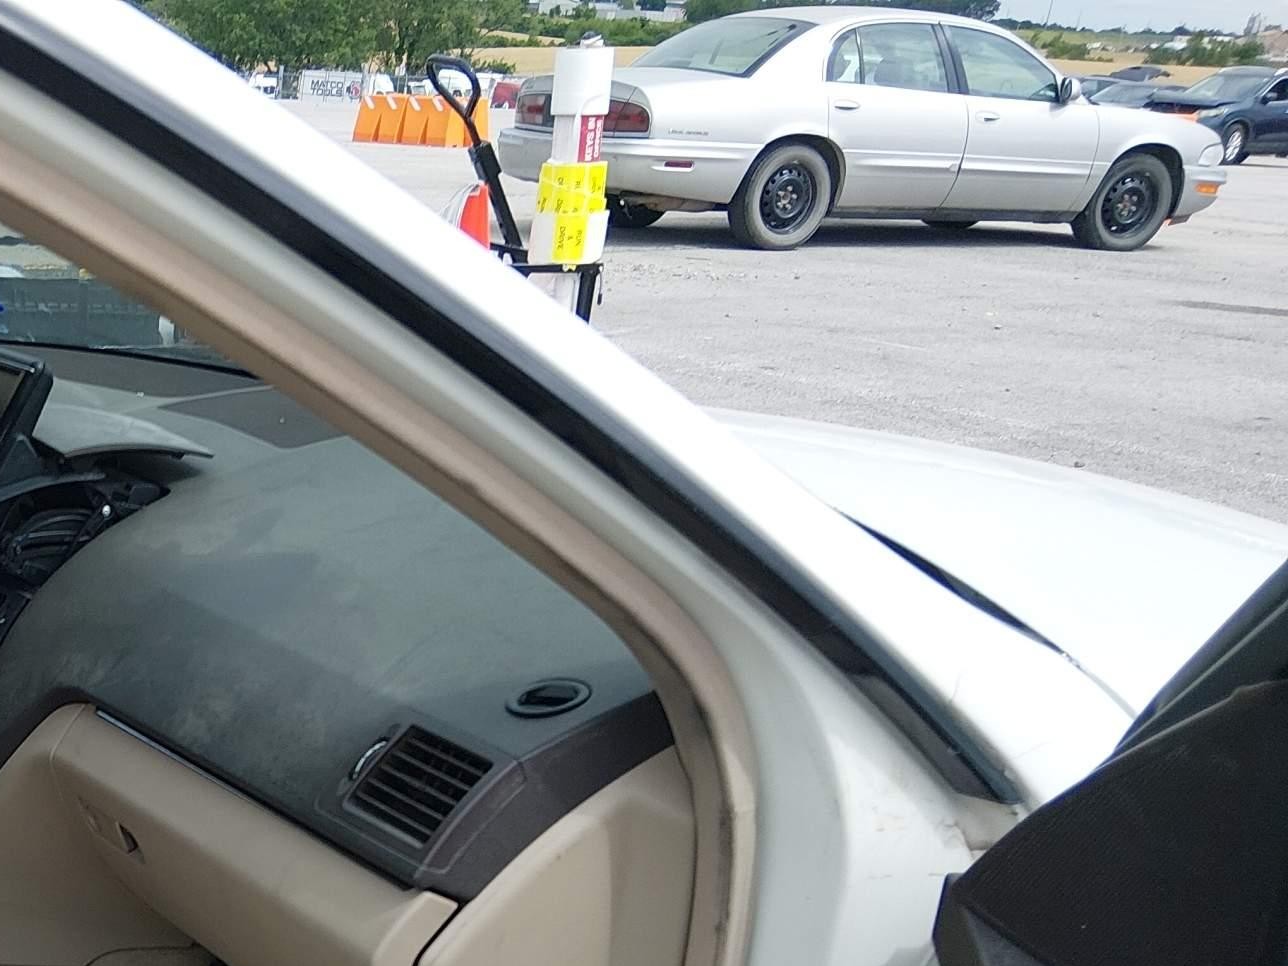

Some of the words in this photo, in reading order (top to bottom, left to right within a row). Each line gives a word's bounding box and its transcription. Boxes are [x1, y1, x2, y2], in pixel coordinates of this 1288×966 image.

[310, 79, 344, 90] MATCO
[311, 88, 343, 98] TOOLS
[587, 116, 597, 130] IN
[584, 130, 595, 162] KEYS
